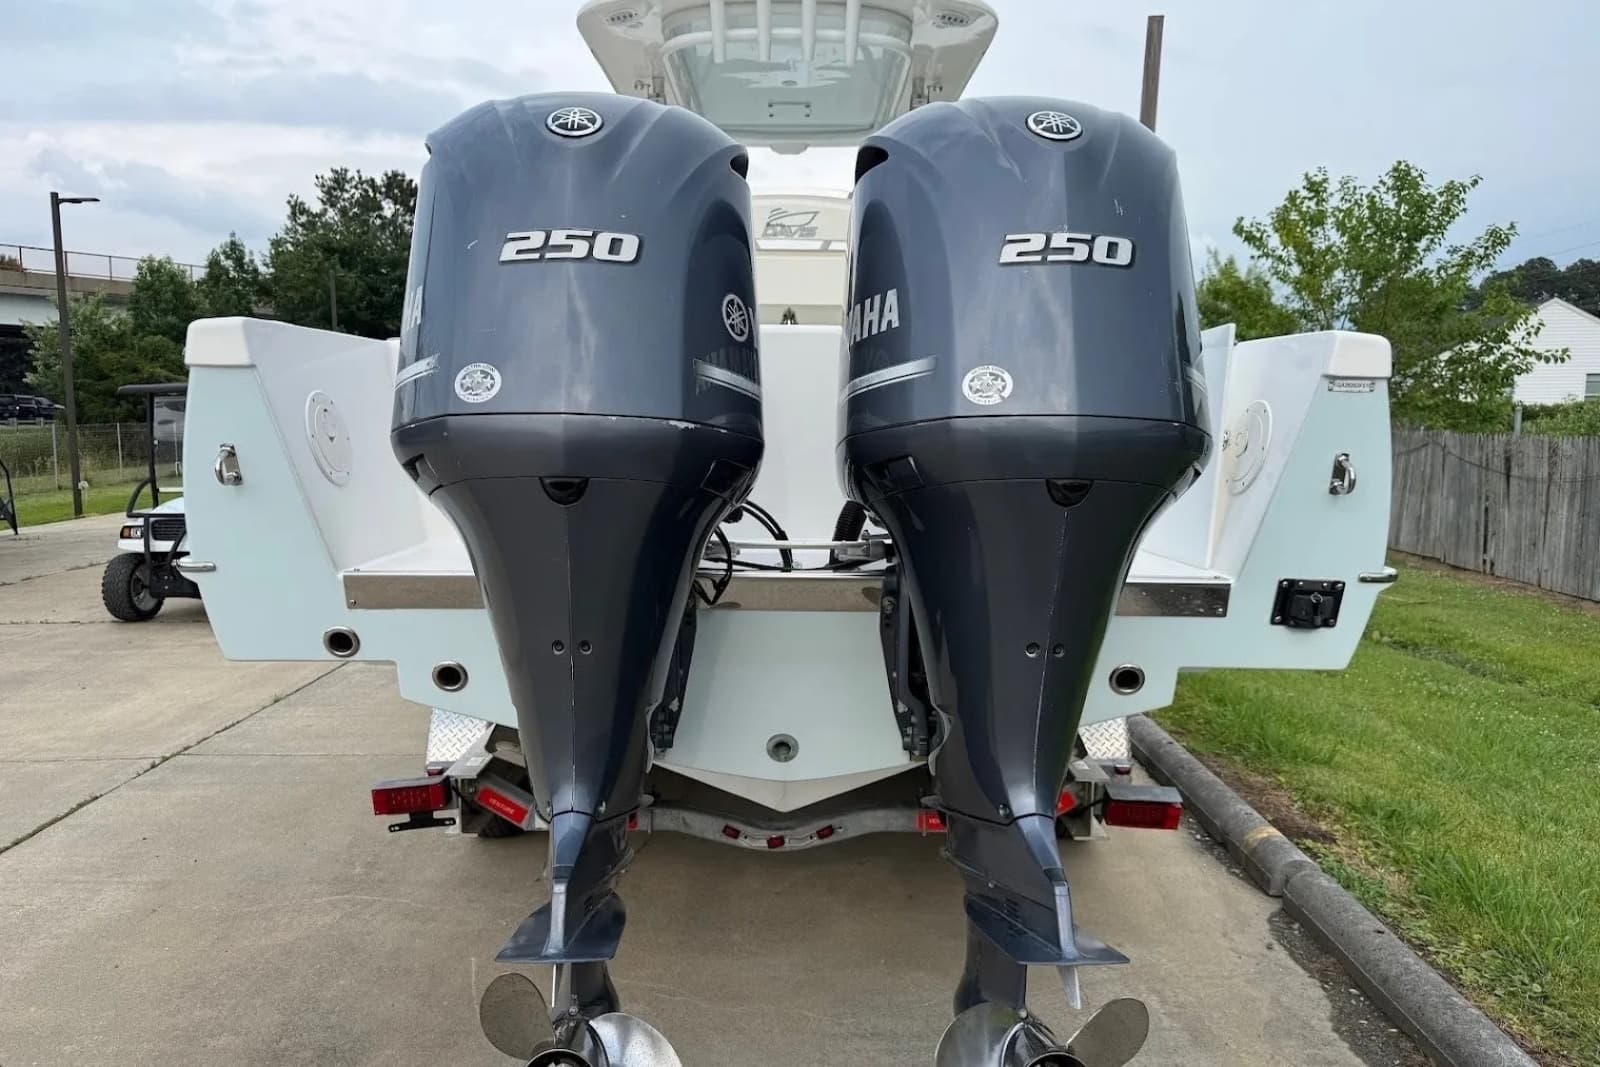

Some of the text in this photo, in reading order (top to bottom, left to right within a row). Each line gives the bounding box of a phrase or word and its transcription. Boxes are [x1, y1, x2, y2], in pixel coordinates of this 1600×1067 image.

[499, 229, 640, 263] 250
[999, 232, 1133, 266] 250
[850, 288, 900, 345] AHA
